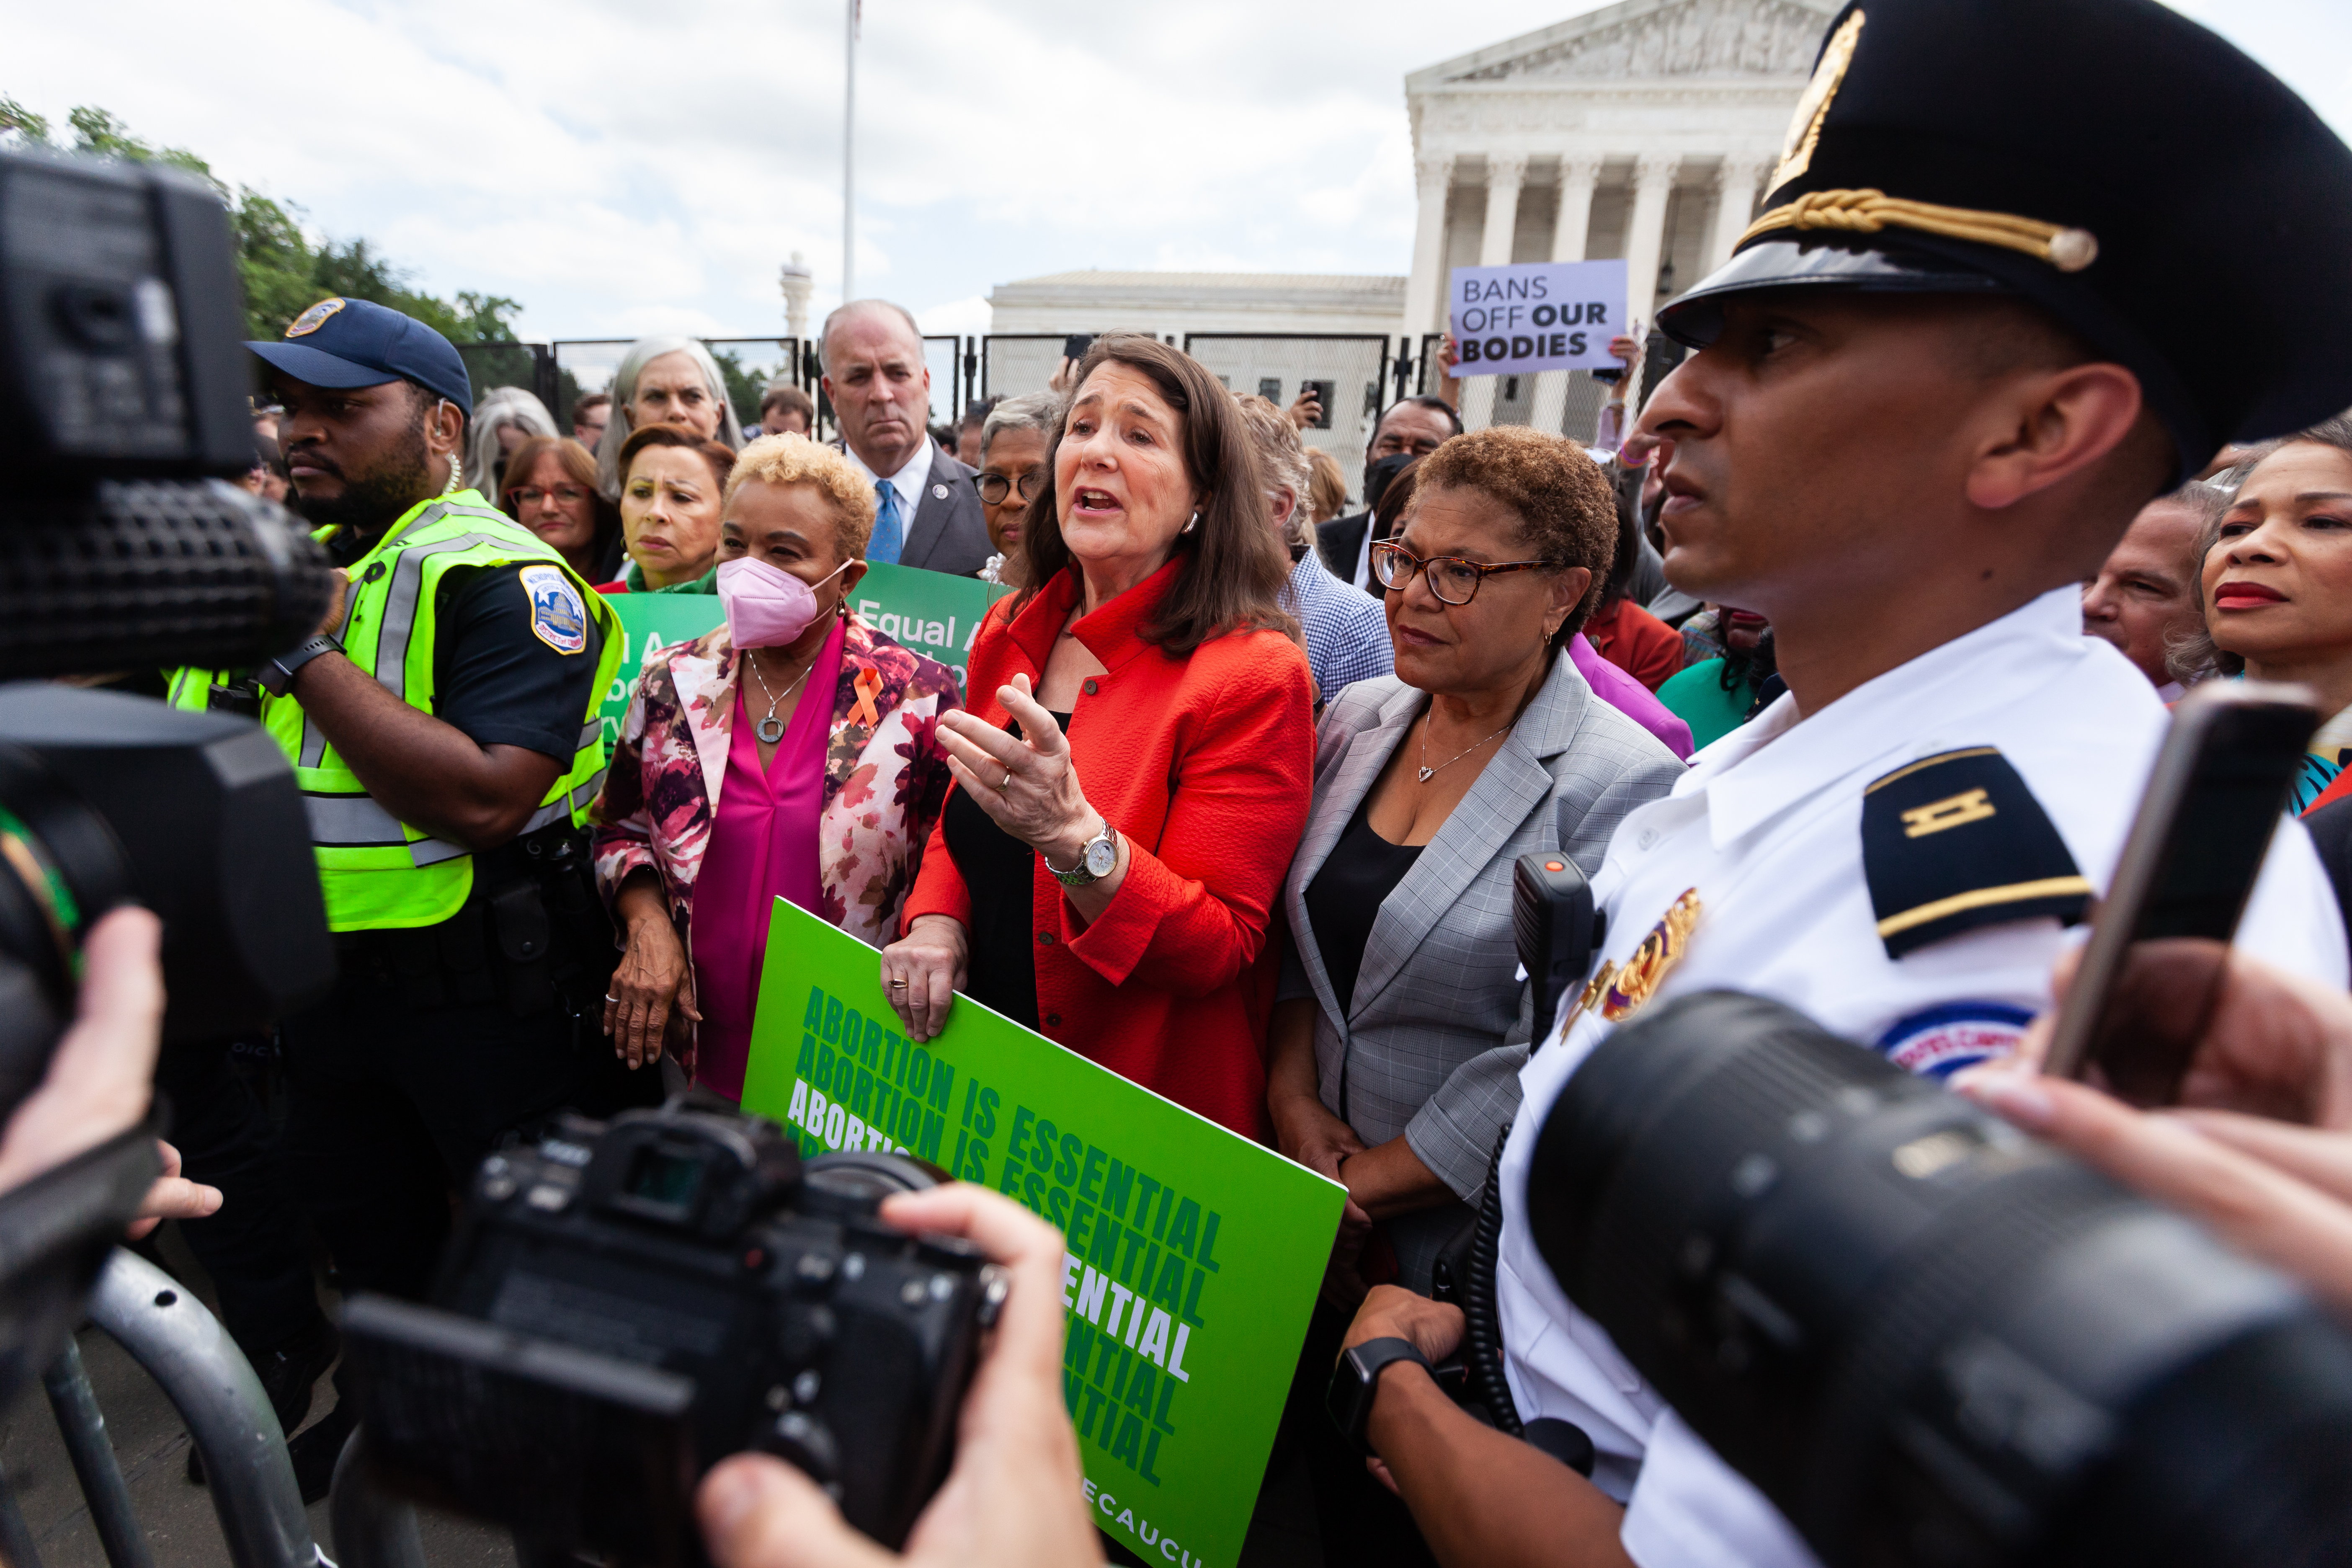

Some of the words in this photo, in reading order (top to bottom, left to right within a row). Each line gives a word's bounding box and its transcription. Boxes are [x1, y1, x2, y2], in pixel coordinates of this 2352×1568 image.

[1463, 305, 1524, 332] OFF
[1532, 302, 1607, 328] OUR
[1464, 276, 1548, 302] BANS
[1462, 332, 1588, 362] BODIES
[859, 599, 955, 648] Equal
[795, 1032, 945, 1165] ABORTION
[951, 1129, 989, 1187] IS
[999, 1157, 1206, 1329] ESSENTIAL
[803, 985, 955, 1114] ABORTION
[962, 1078, 1000, 1139] IS
[1008, 1105, 1221, 1274] ESSENTIAL
[787, 1078, 911, 1157] ABORT
[1060, 1251, 1191, 1383] ENTIAL
[1064, 1310, 1176, 1437] NTIAL
[1063, 1367, 1162, 1488] NTIAL
[1081, 1477, 1202, 1568] ECAUCU
